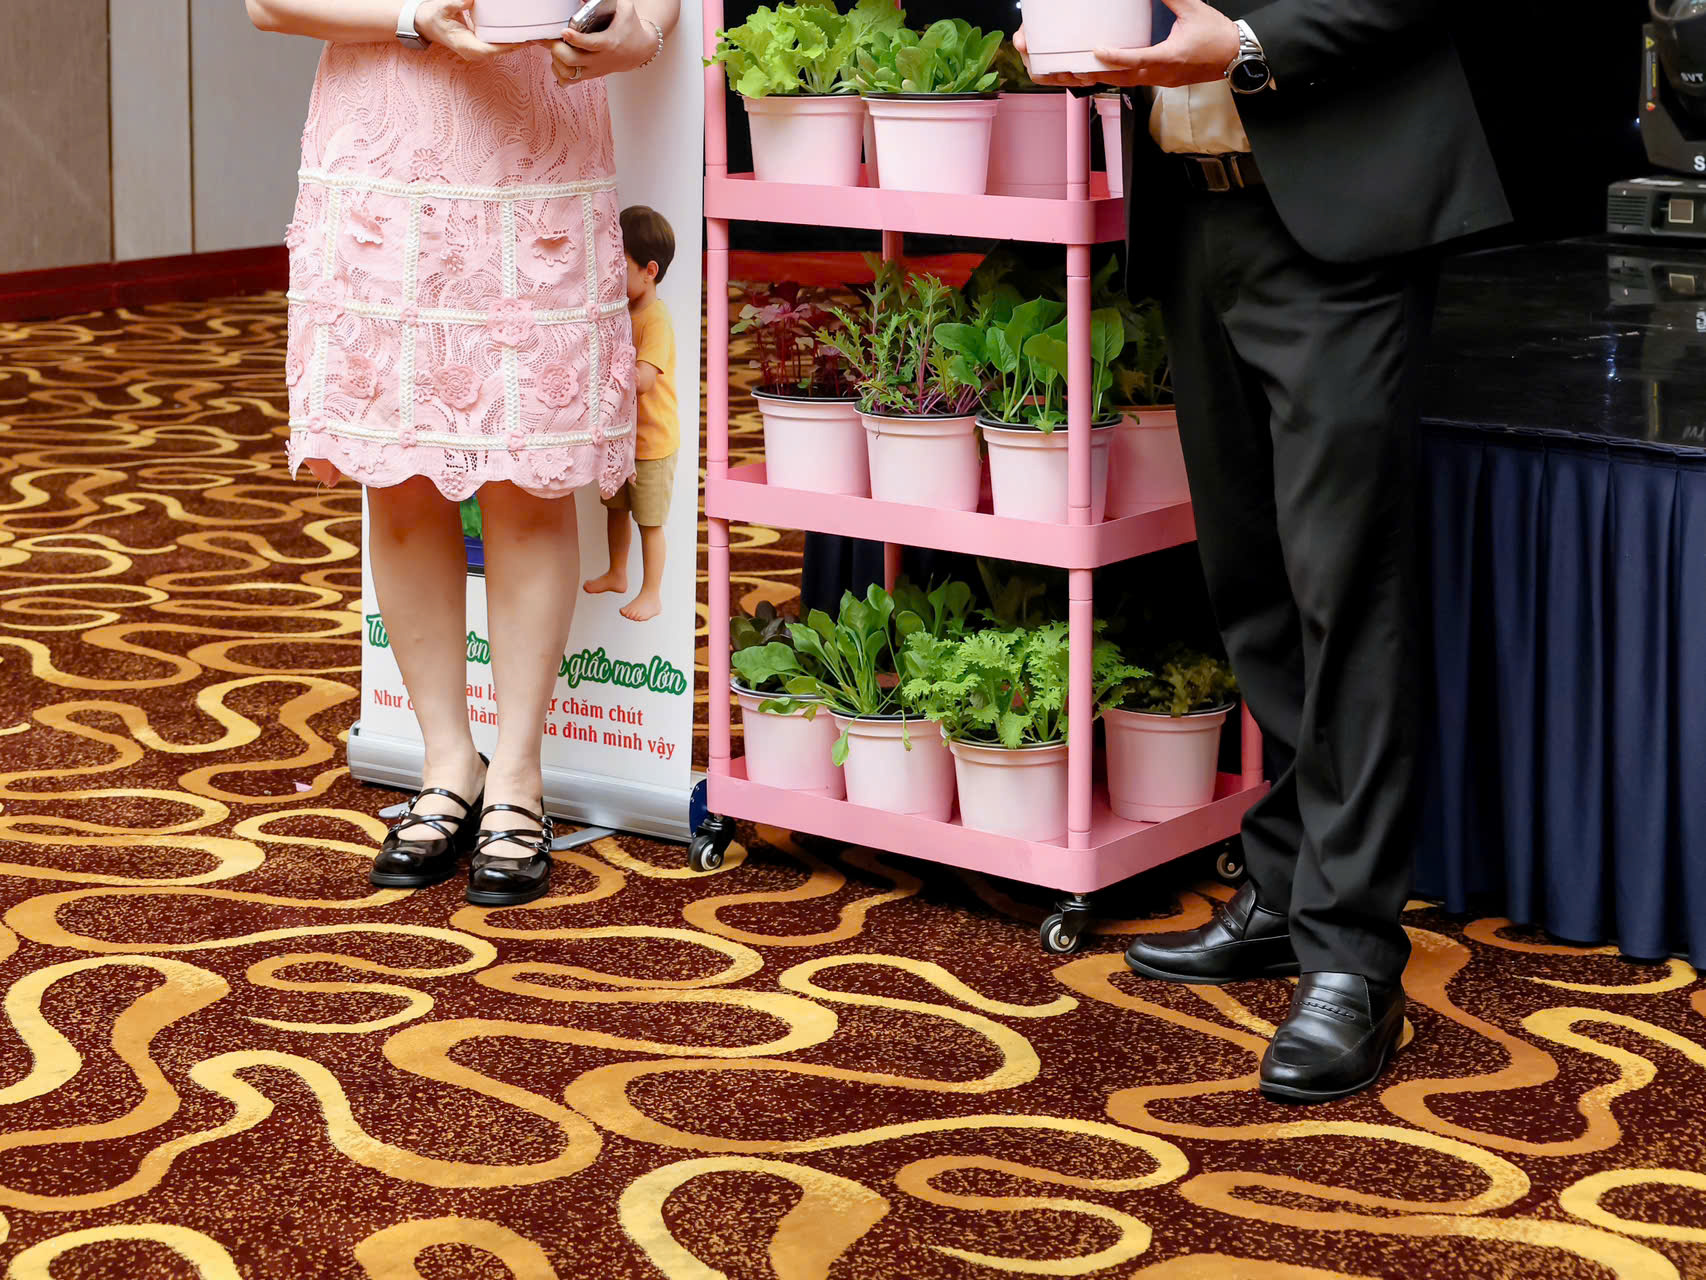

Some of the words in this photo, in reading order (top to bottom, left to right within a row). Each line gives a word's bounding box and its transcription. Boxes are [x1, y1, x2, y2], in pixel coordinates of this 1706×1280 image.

[568, 648, 610, 688] giấc
[612, 660, 647, 688] mơ
[649, 656, 687, 695] lớn
[374, 689, 403, 709] Như
[544, 718, 557, 737] ia
[562, 721, 598, 744] đình
[603, 729, 643, 752] mình
[648, 736, 675, 761] vậy
[562, 697, 603, 720] chăm
[609, 704, 643, 726] chút
